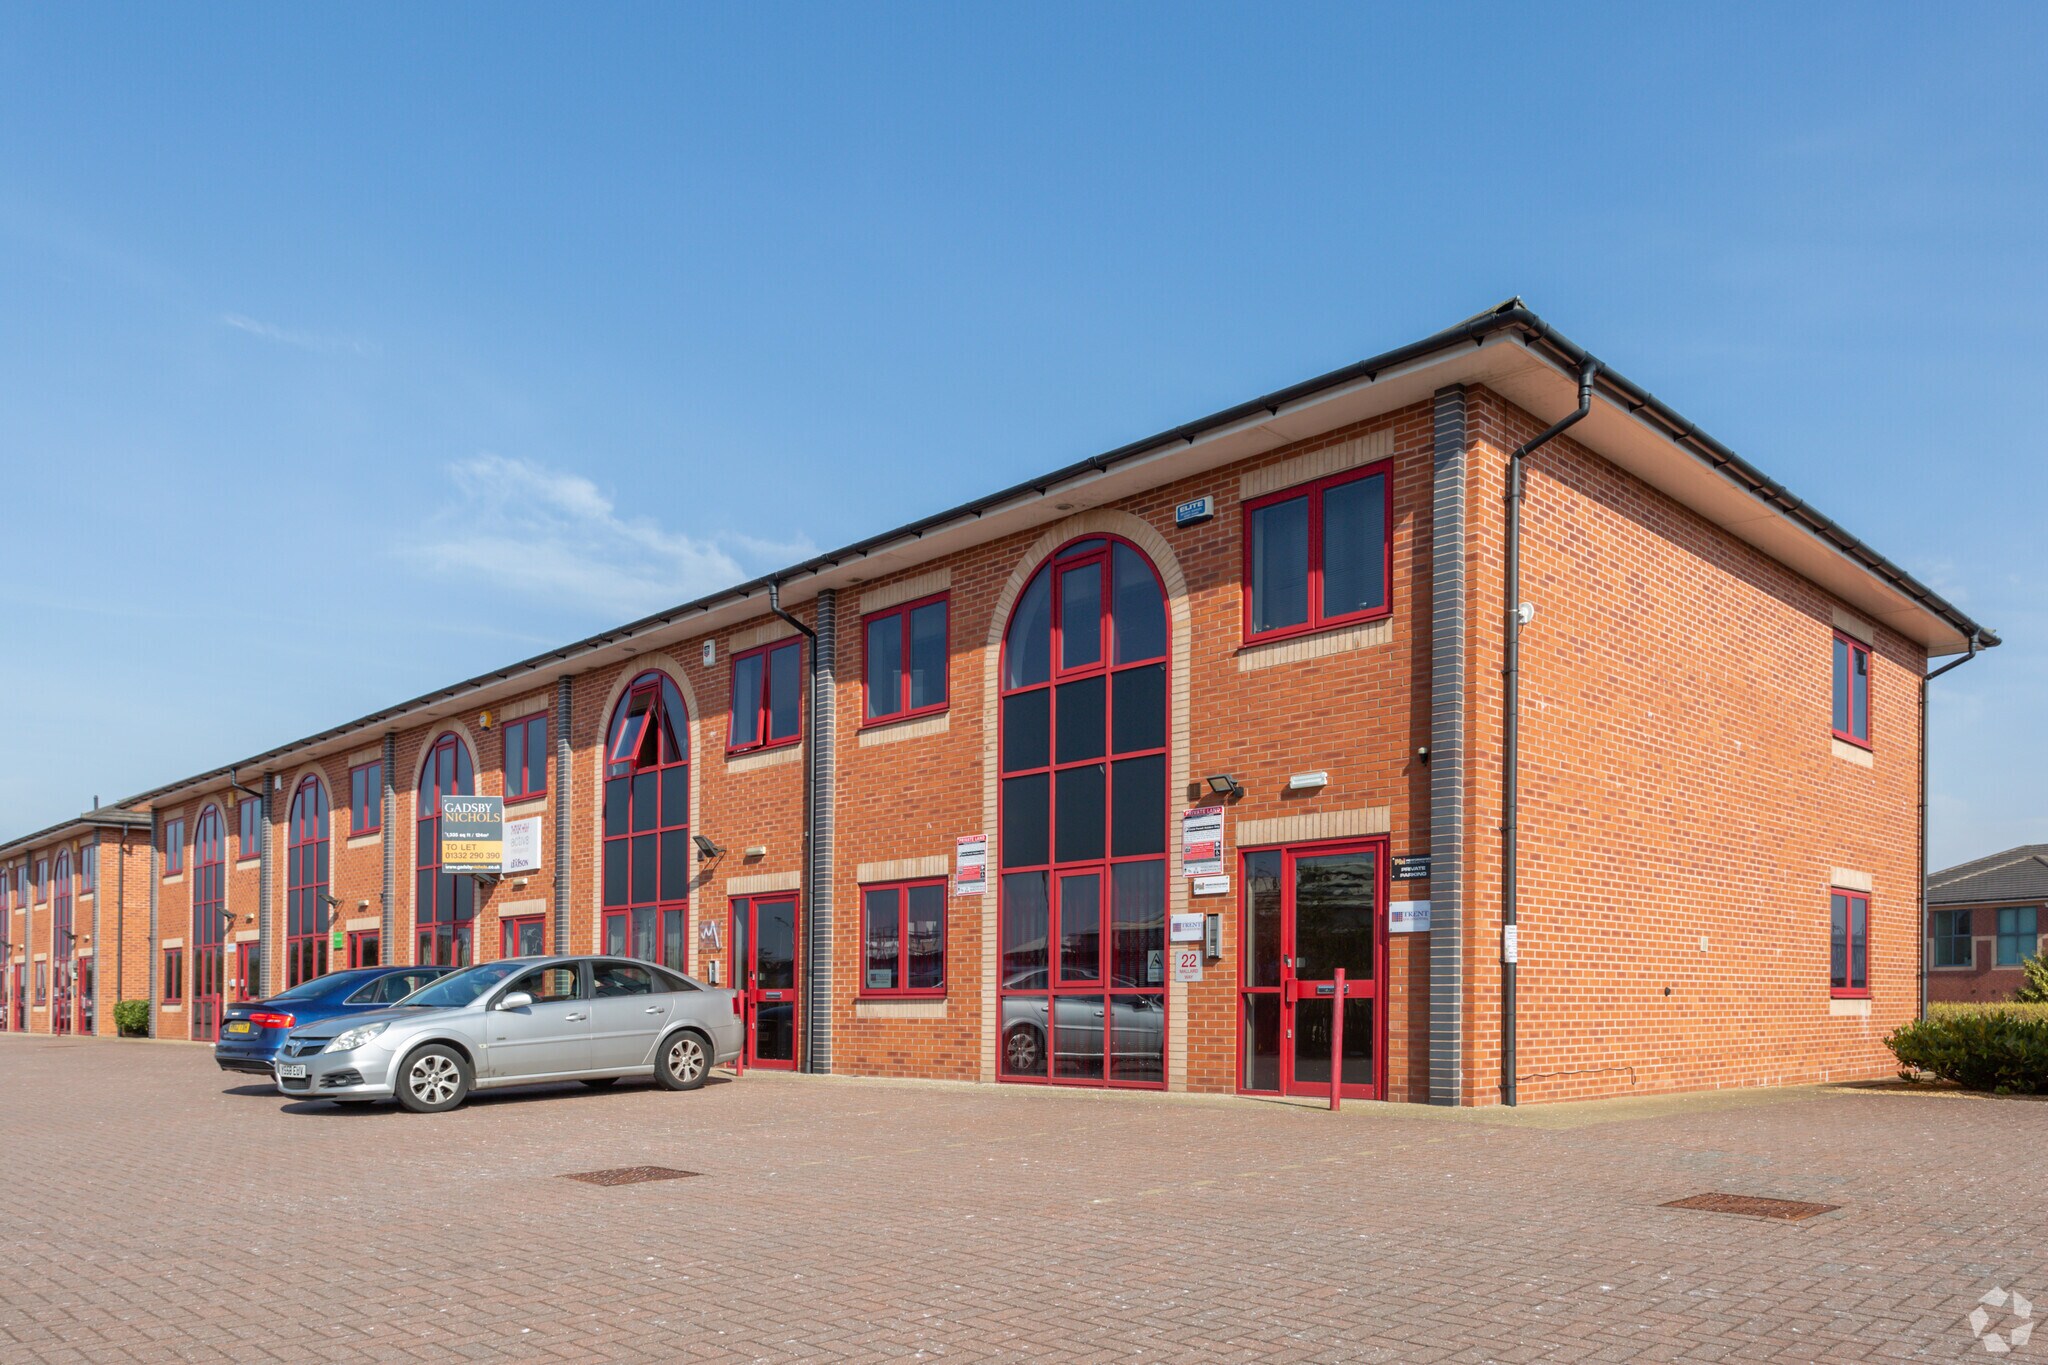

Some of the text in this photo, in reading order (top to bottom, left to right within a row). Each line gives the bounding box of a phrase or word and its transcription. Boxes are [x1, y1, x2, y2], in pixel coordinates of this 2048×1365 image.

[1180, 501, 1203, 512] ELITE
[444, 803, 492, 813] GADSBY
[445, 813, 500, 822] NICHOLS
[446, 843, 477, 851] TO LET
[1181, 953, 1197, 968] 22
